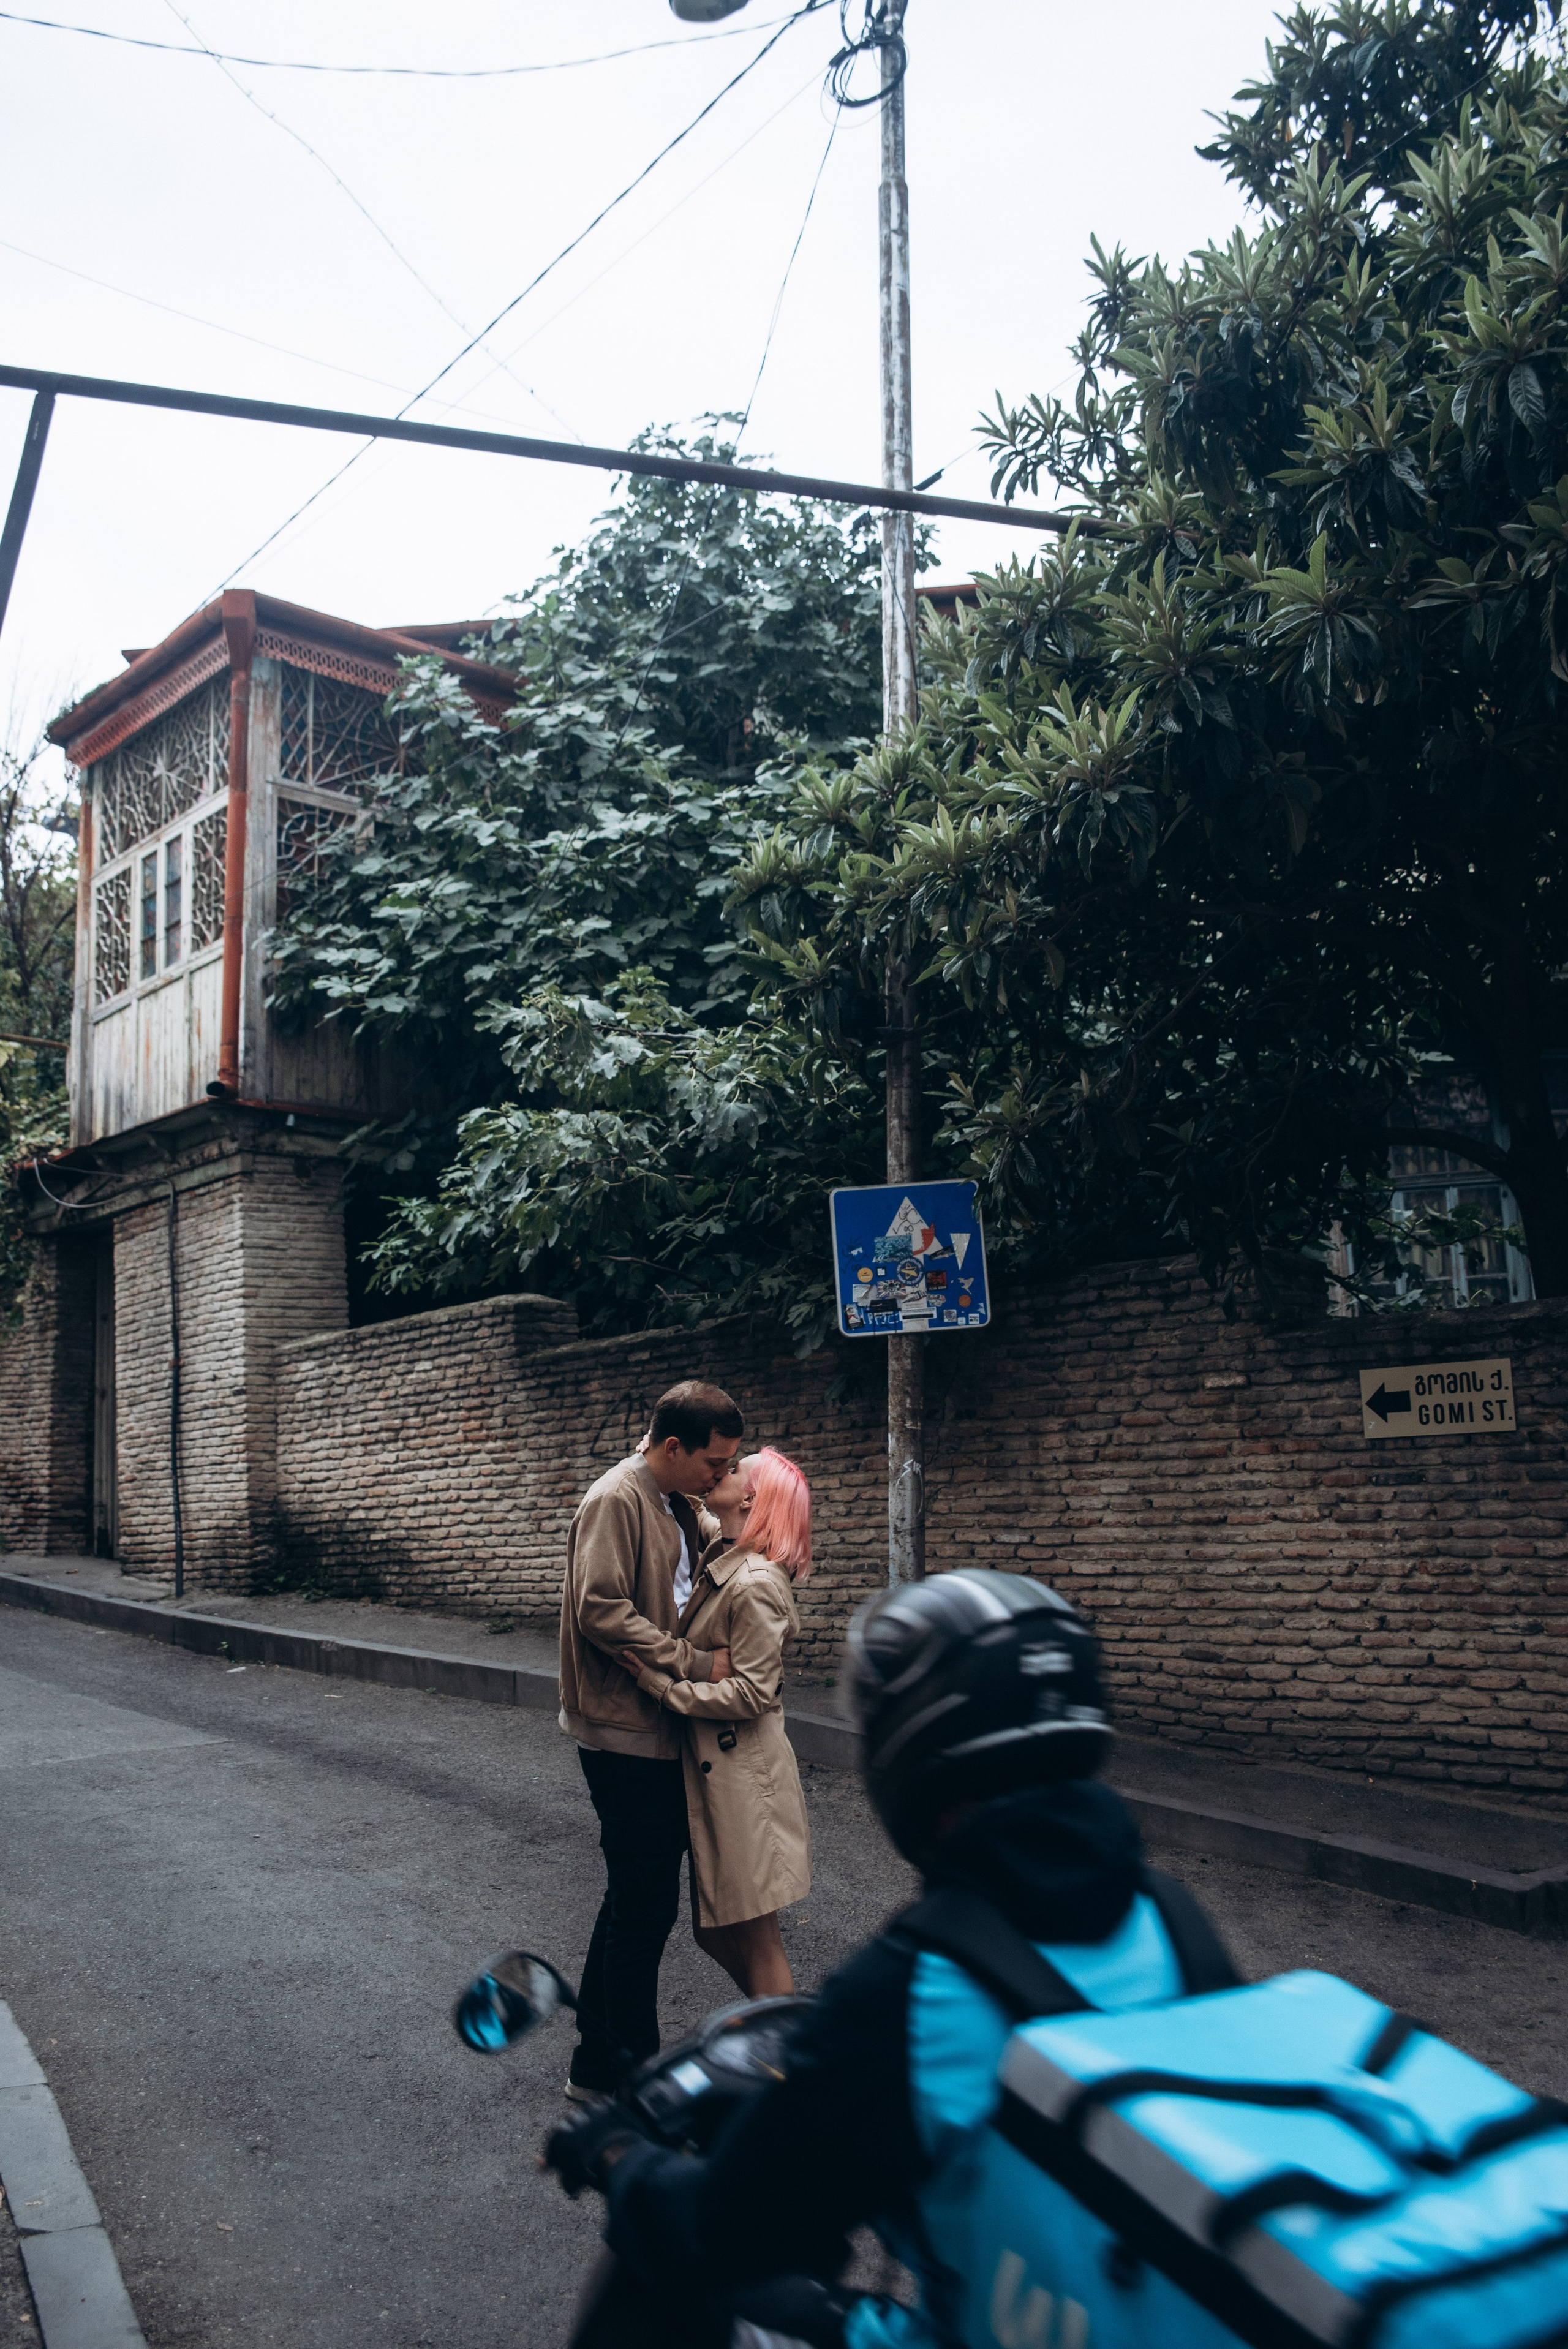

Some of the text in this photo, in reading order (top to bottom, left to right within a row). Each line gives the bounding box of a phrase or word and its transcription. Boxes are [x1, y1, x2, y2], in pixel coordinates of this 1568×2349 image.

[1415, 1369, 1509, 1396] გომის ქ.
[1418, 1399, 1513, 1425] GOMI ST.
